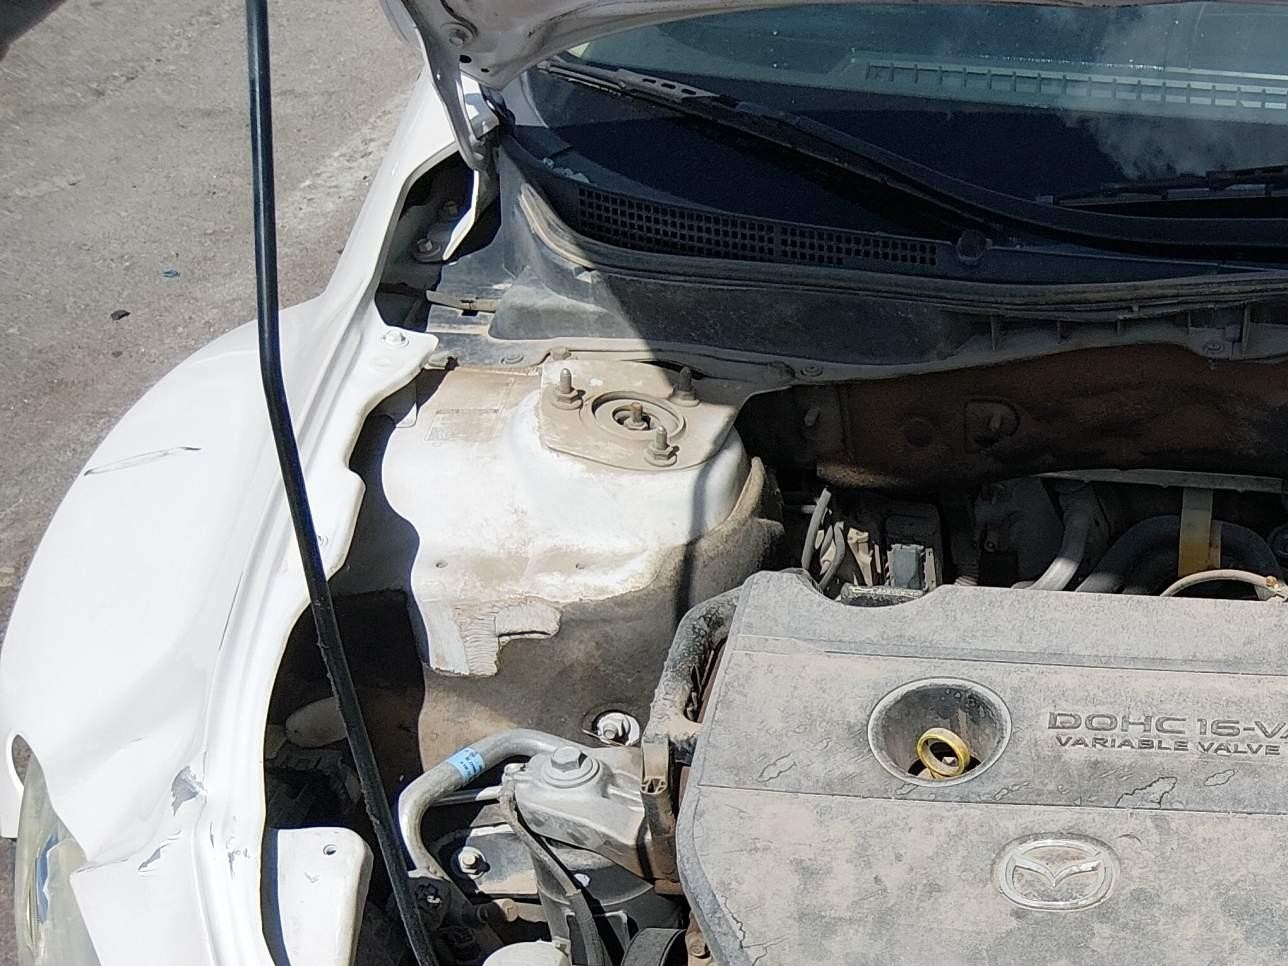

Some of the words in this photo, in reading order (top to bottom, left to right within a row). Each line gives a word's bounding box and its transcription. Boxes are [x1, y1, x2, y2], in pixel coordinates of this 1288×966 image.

[1047, 711, 1188, 736] DOHC
[1055, 735, 1190, 752] VARIABLE
[1198, 741, 1281, 756] VALVE
